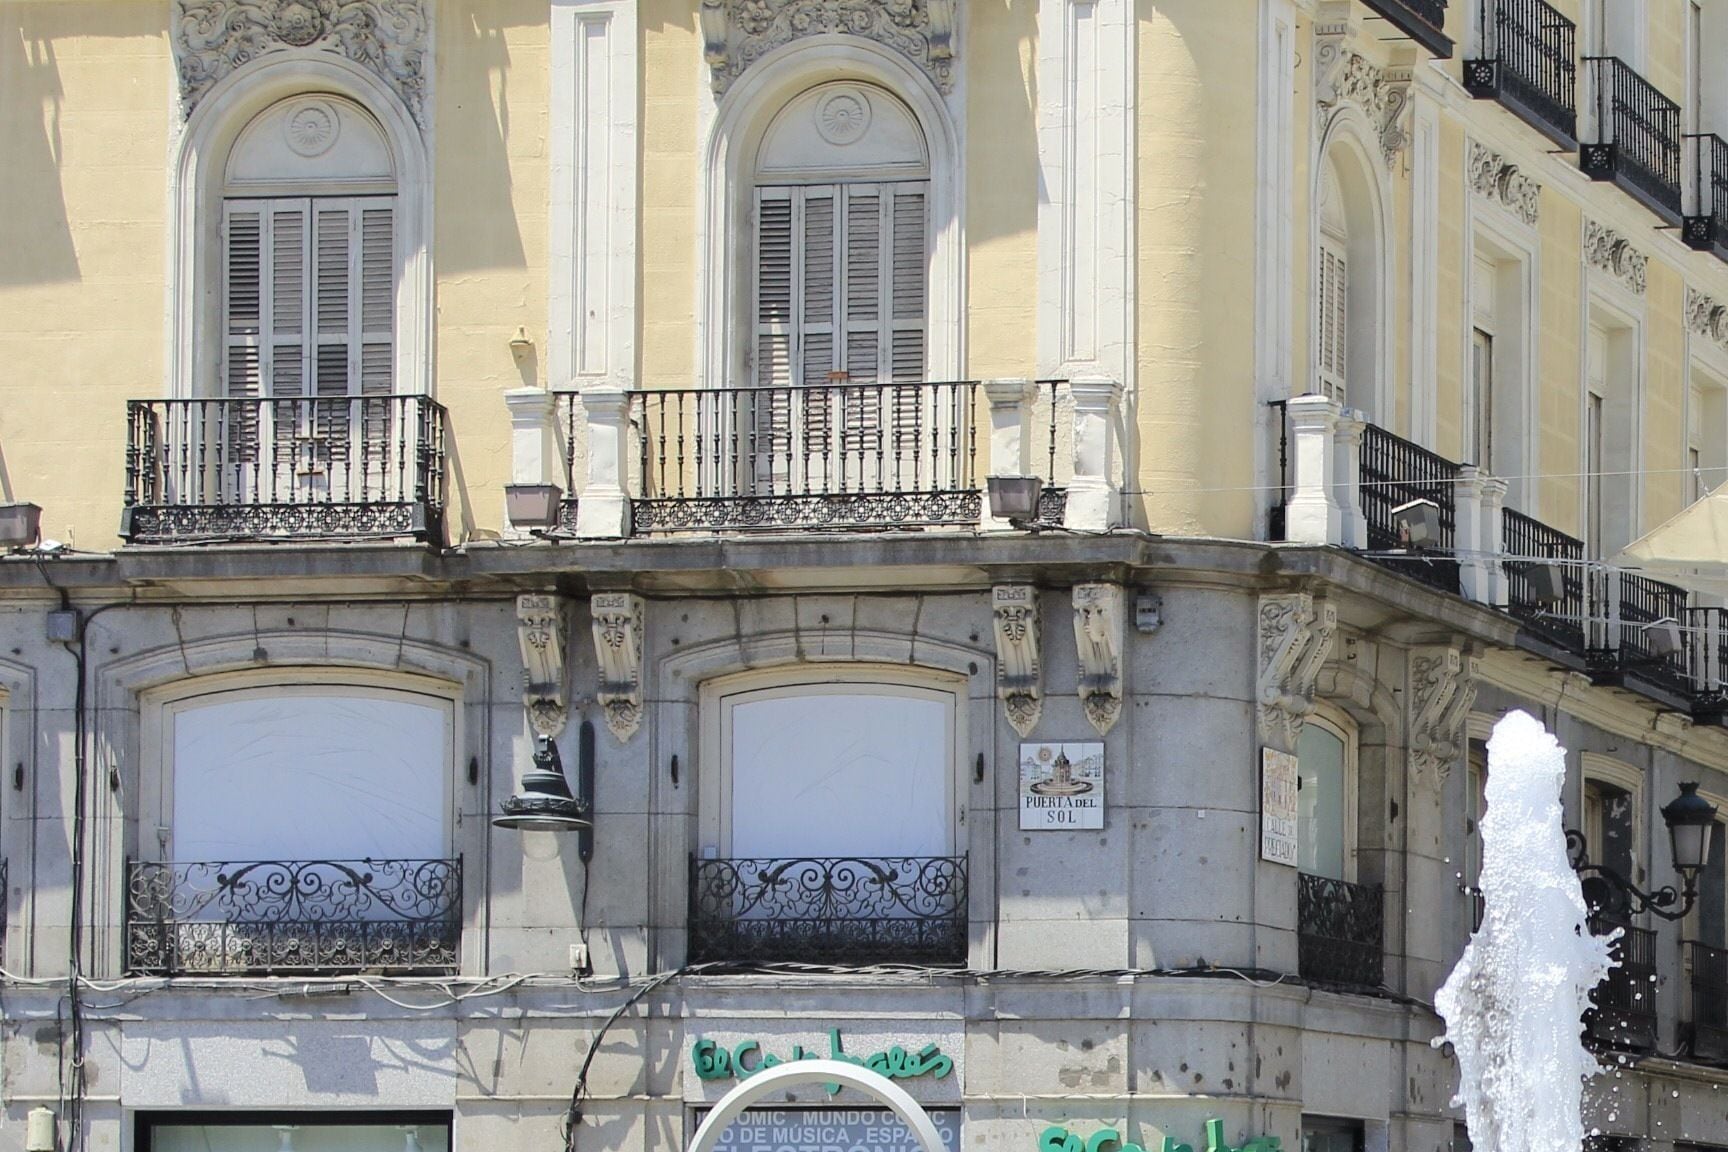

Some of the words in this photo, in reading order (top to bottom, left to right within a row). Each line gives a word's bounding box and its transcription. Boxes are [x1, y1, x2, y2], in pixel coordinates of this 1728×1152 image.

[1026, 796, 1072, 808] PUERTA
[1076, 799, 1096, 808] DEL
[1047, 810, 1076, 823] SOL
[692, 1039, 732, 1081] El
[803, 1111, 876, 1126] MUNDO
[740, 1127, 767, 1143] DE
[772, 1123, 850, 1143] MÚSICA
